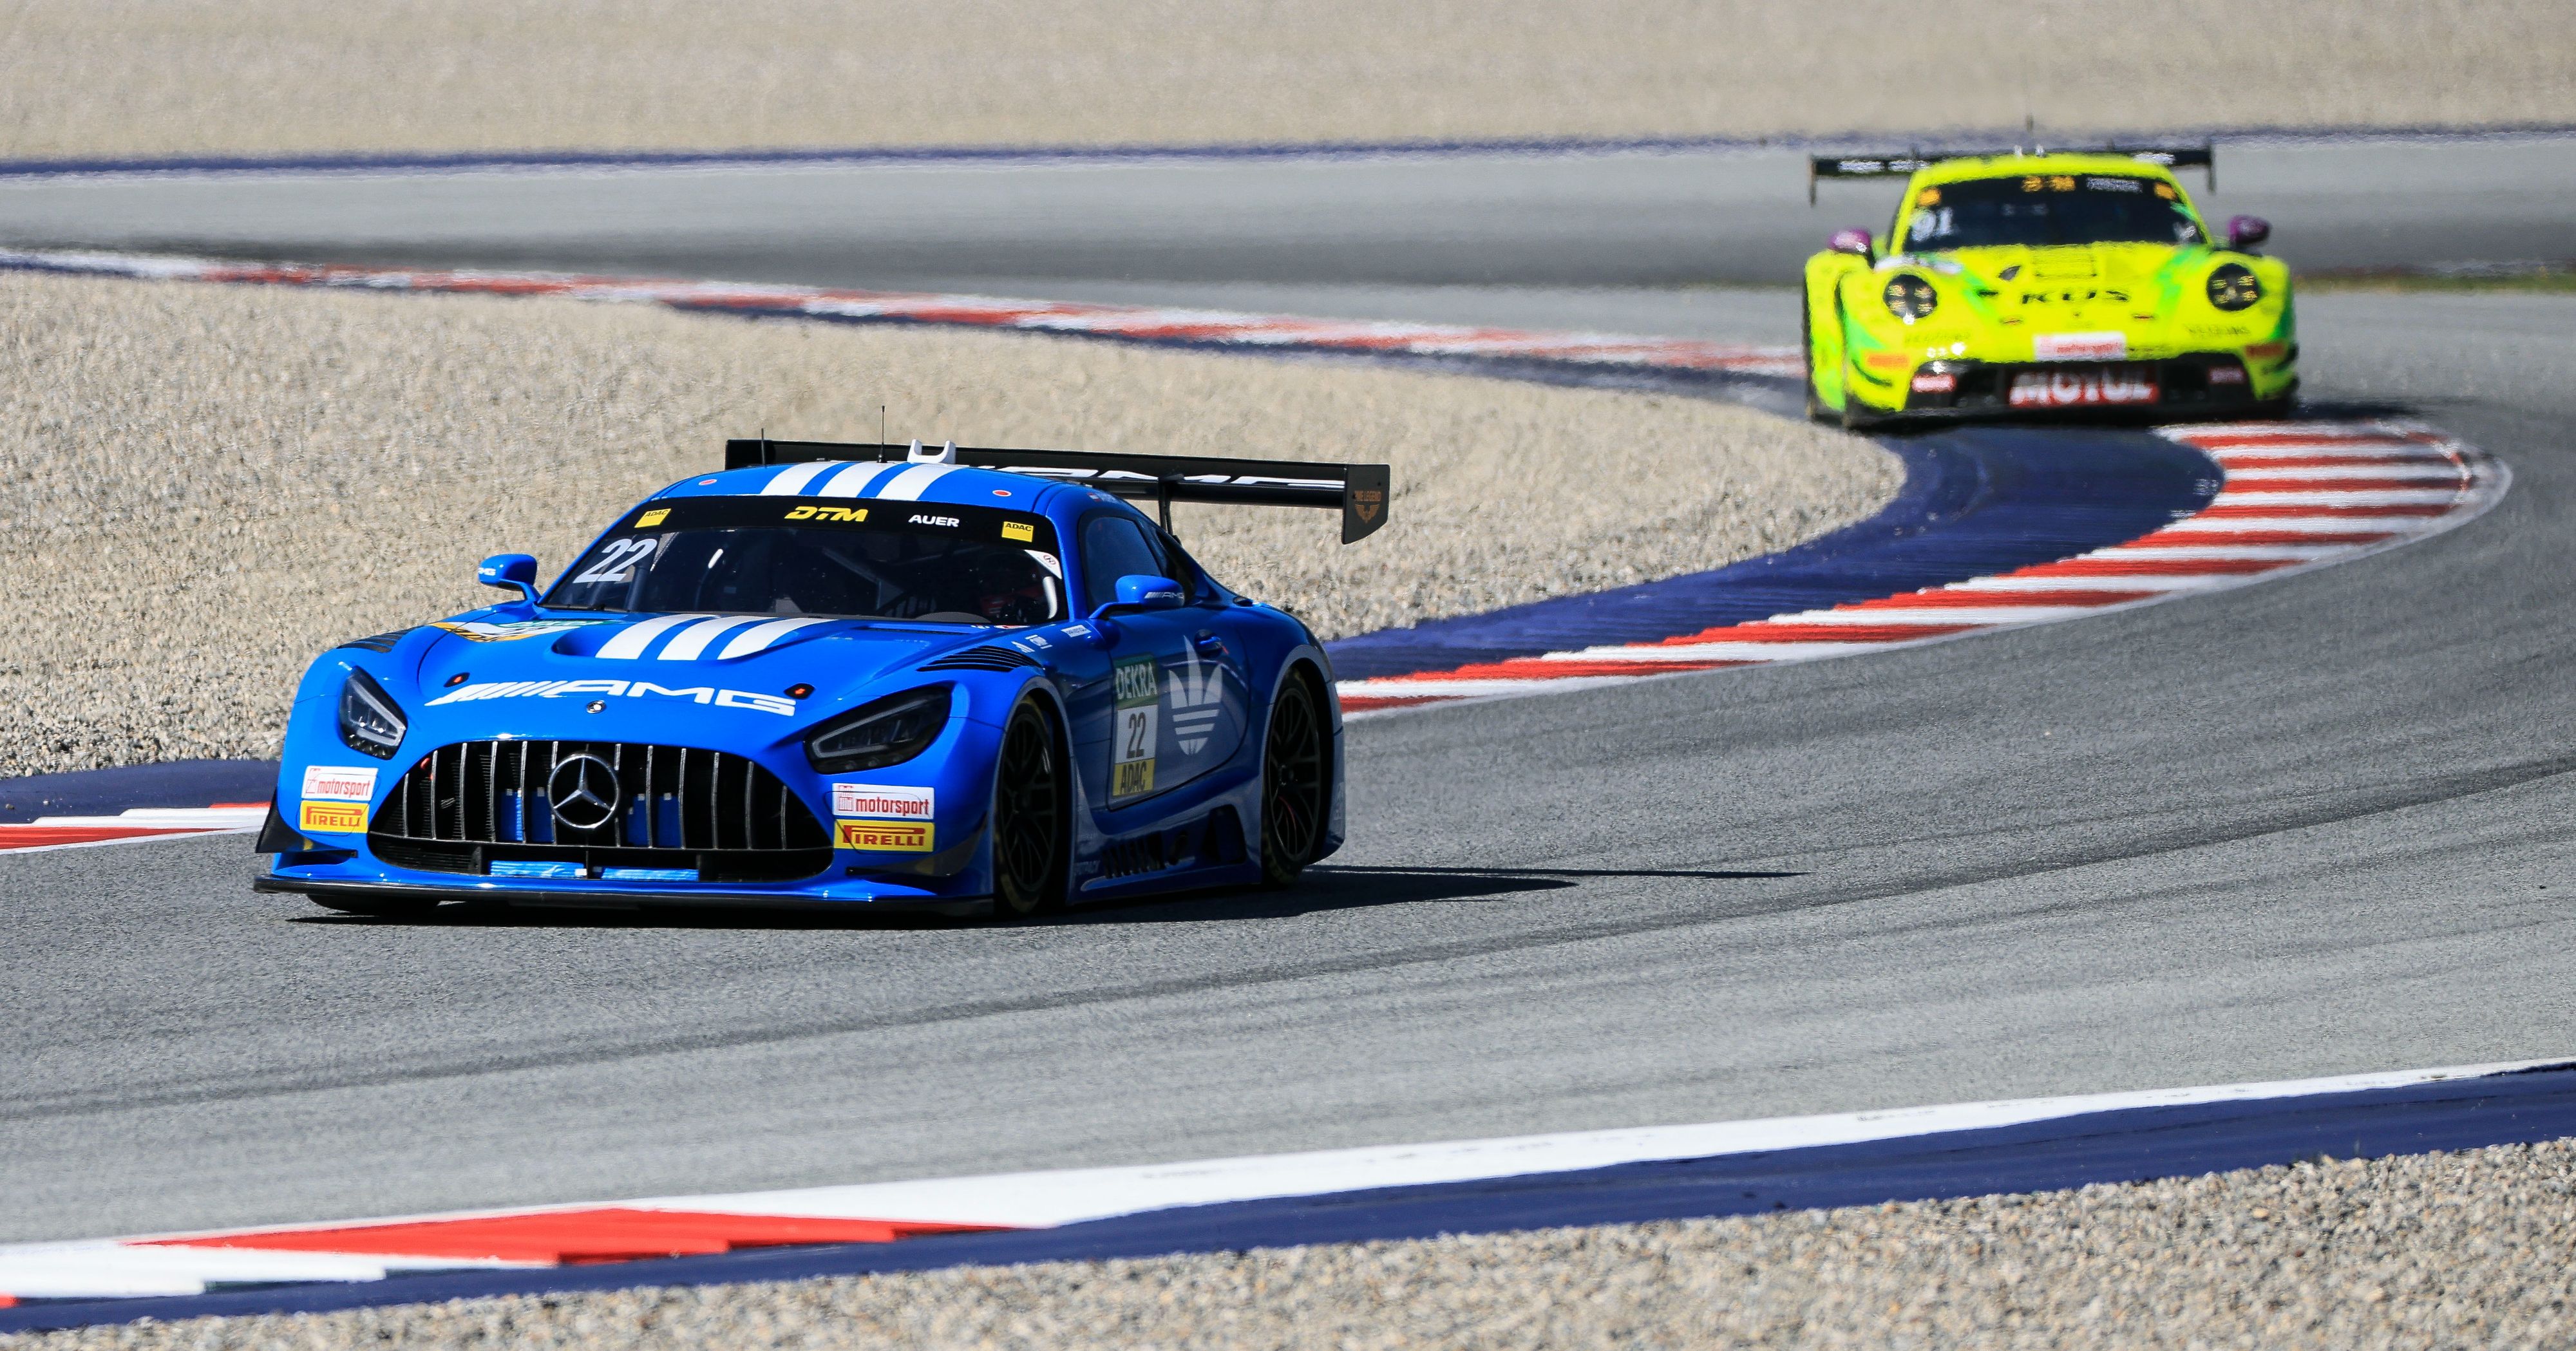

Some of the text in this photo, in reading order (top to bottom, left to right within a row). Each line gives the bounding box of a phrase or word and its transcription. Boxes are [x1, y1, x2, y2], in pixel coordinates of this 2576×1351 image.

[784, 505, 869, 522] DTM
[908, 515, 960, 527] AUER
[1005, 523, 1032, 532] ADAC
[573, 538, 658, 583] 22
[1115, 662, 1158, 700] DEKRA
[544, 679, 797, 716] AMG
[1126, 712, 1146, 759] 22
[316, 778, 371, 798] motorsport
[1119, 761, 1147, 795] ADAC
[306, 806, 362, 827] PIRELLI
[856, 797, 929, 817] motorsport
[842, 825, 926, 846] PIRELLI
